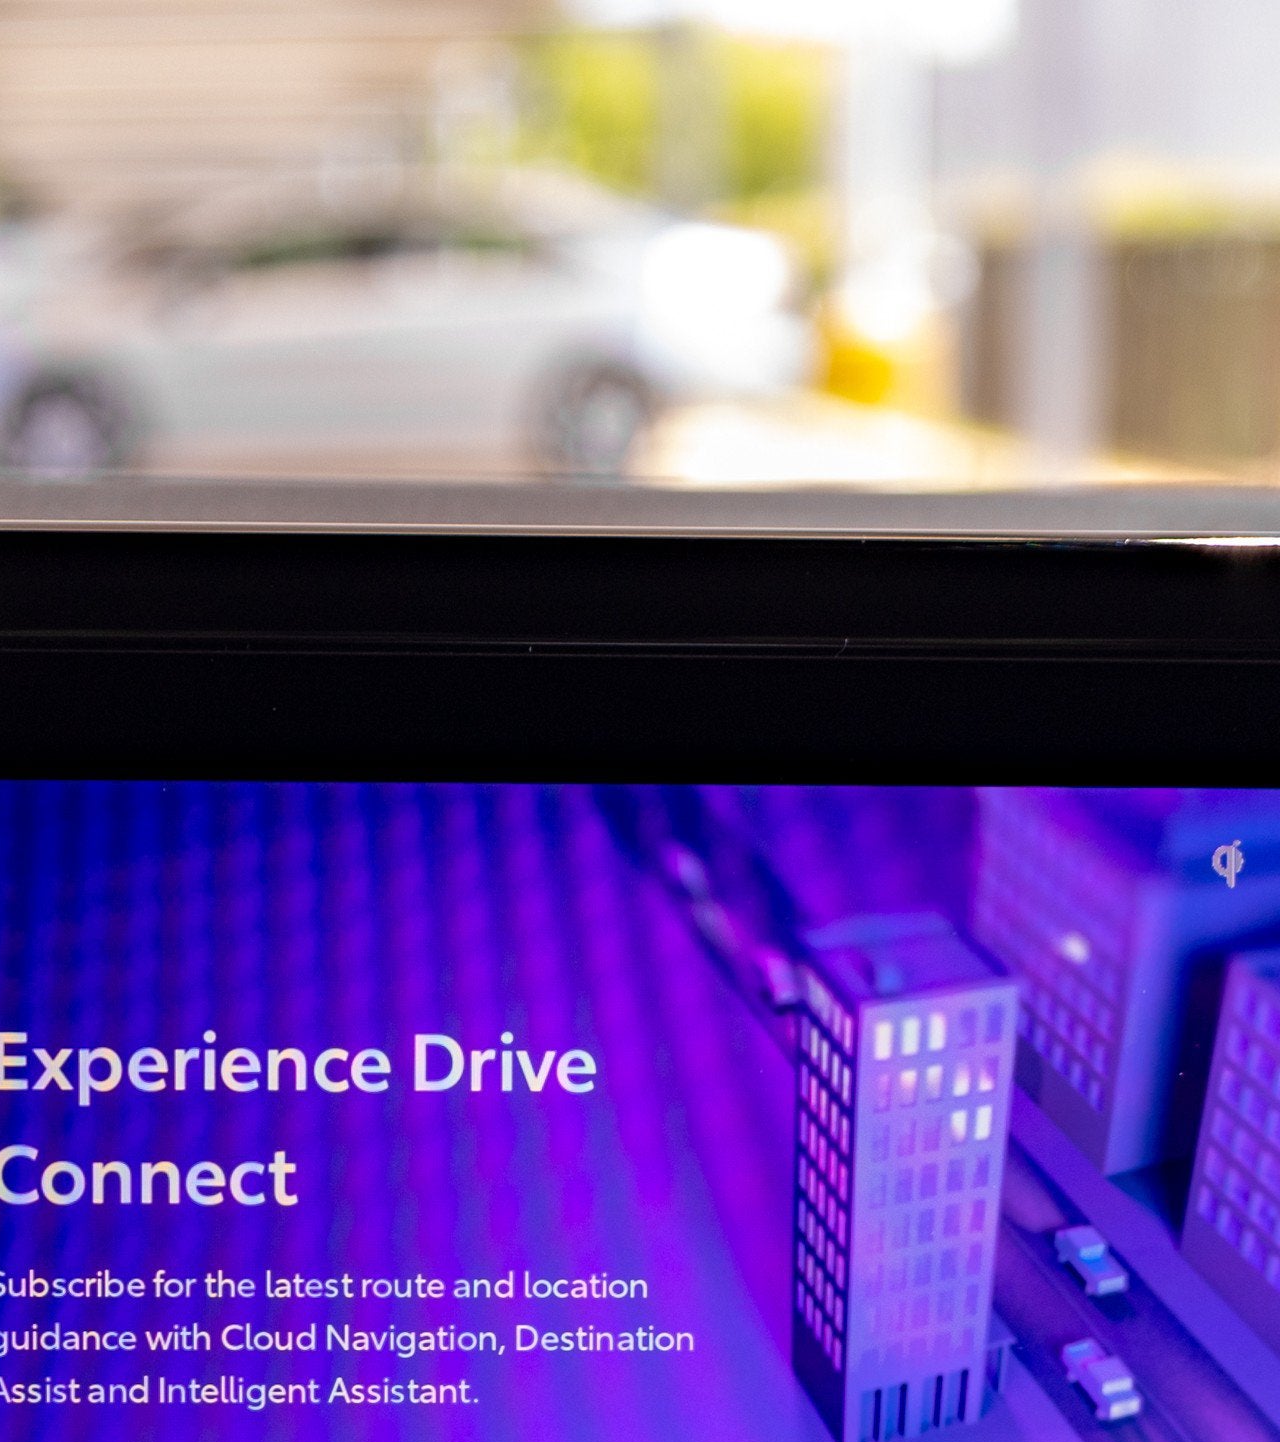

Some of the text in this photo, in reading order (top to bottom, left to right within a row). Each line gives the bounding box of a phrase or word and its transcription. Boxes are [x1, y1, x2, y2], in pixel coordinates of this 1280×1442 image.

[413, 1030, 597, 1093] Drive
[152, 1269, 197, 1298] for
[204, 1269, 256, 1298] the
[265, 1269, 354, 1298] latest
[360, 1273, 446, 1299] route
[452, 1270, 515, 1299] and
[523, 1270, 649, 1299] location
[144, 1322, 212, 1351] with
[220, 1322, 317, 1352] Cloud
[325, 1323, 506, 1359] Navigation,
[514, 1324, 695, 1352] Destination
[87, 1374, 149, 1404] and
[158, 1374, 321, 1411] Intelligent
[327, 1375, 480, 1405] Assistant.
